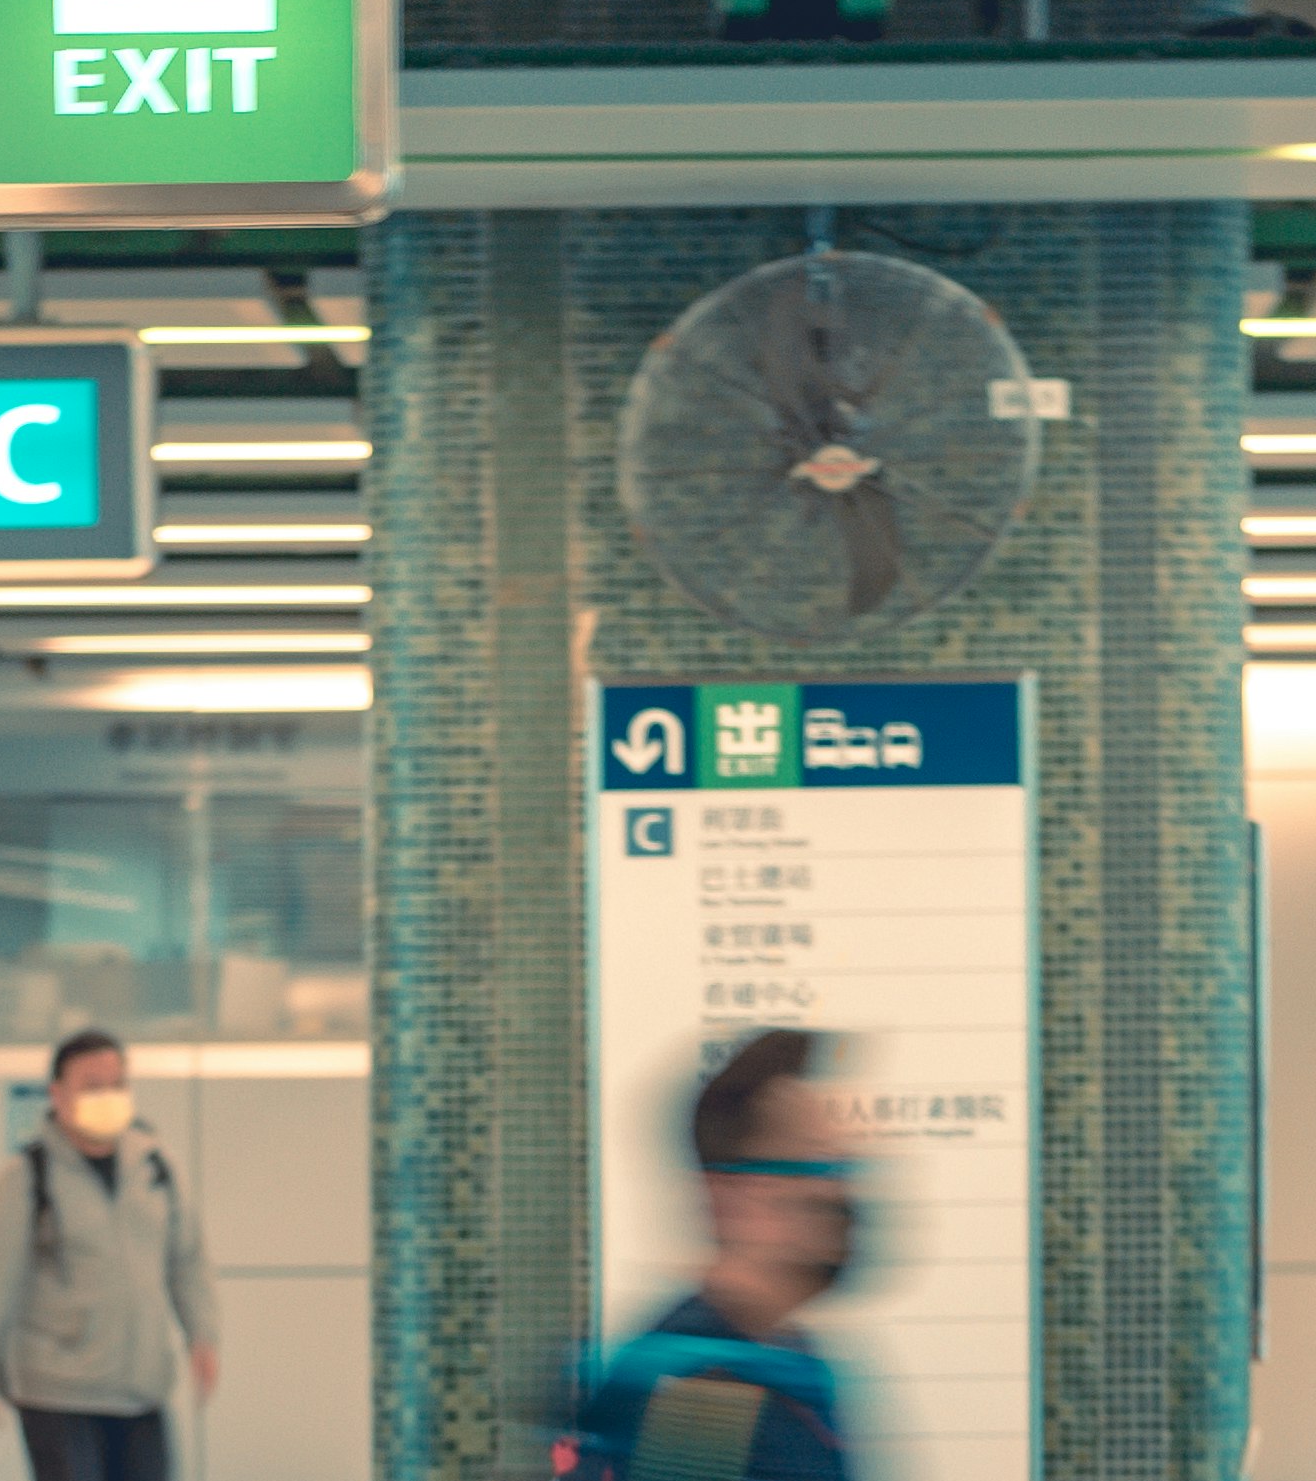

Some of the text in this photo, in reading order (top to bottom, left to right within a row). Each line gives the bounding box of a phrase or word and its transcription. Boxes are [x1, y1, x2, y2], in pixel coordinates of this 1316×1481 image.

[53, 46, 278, 115] EXIT
[714, 701, 783, 755] 出
[633, 813, 665, 851] C
